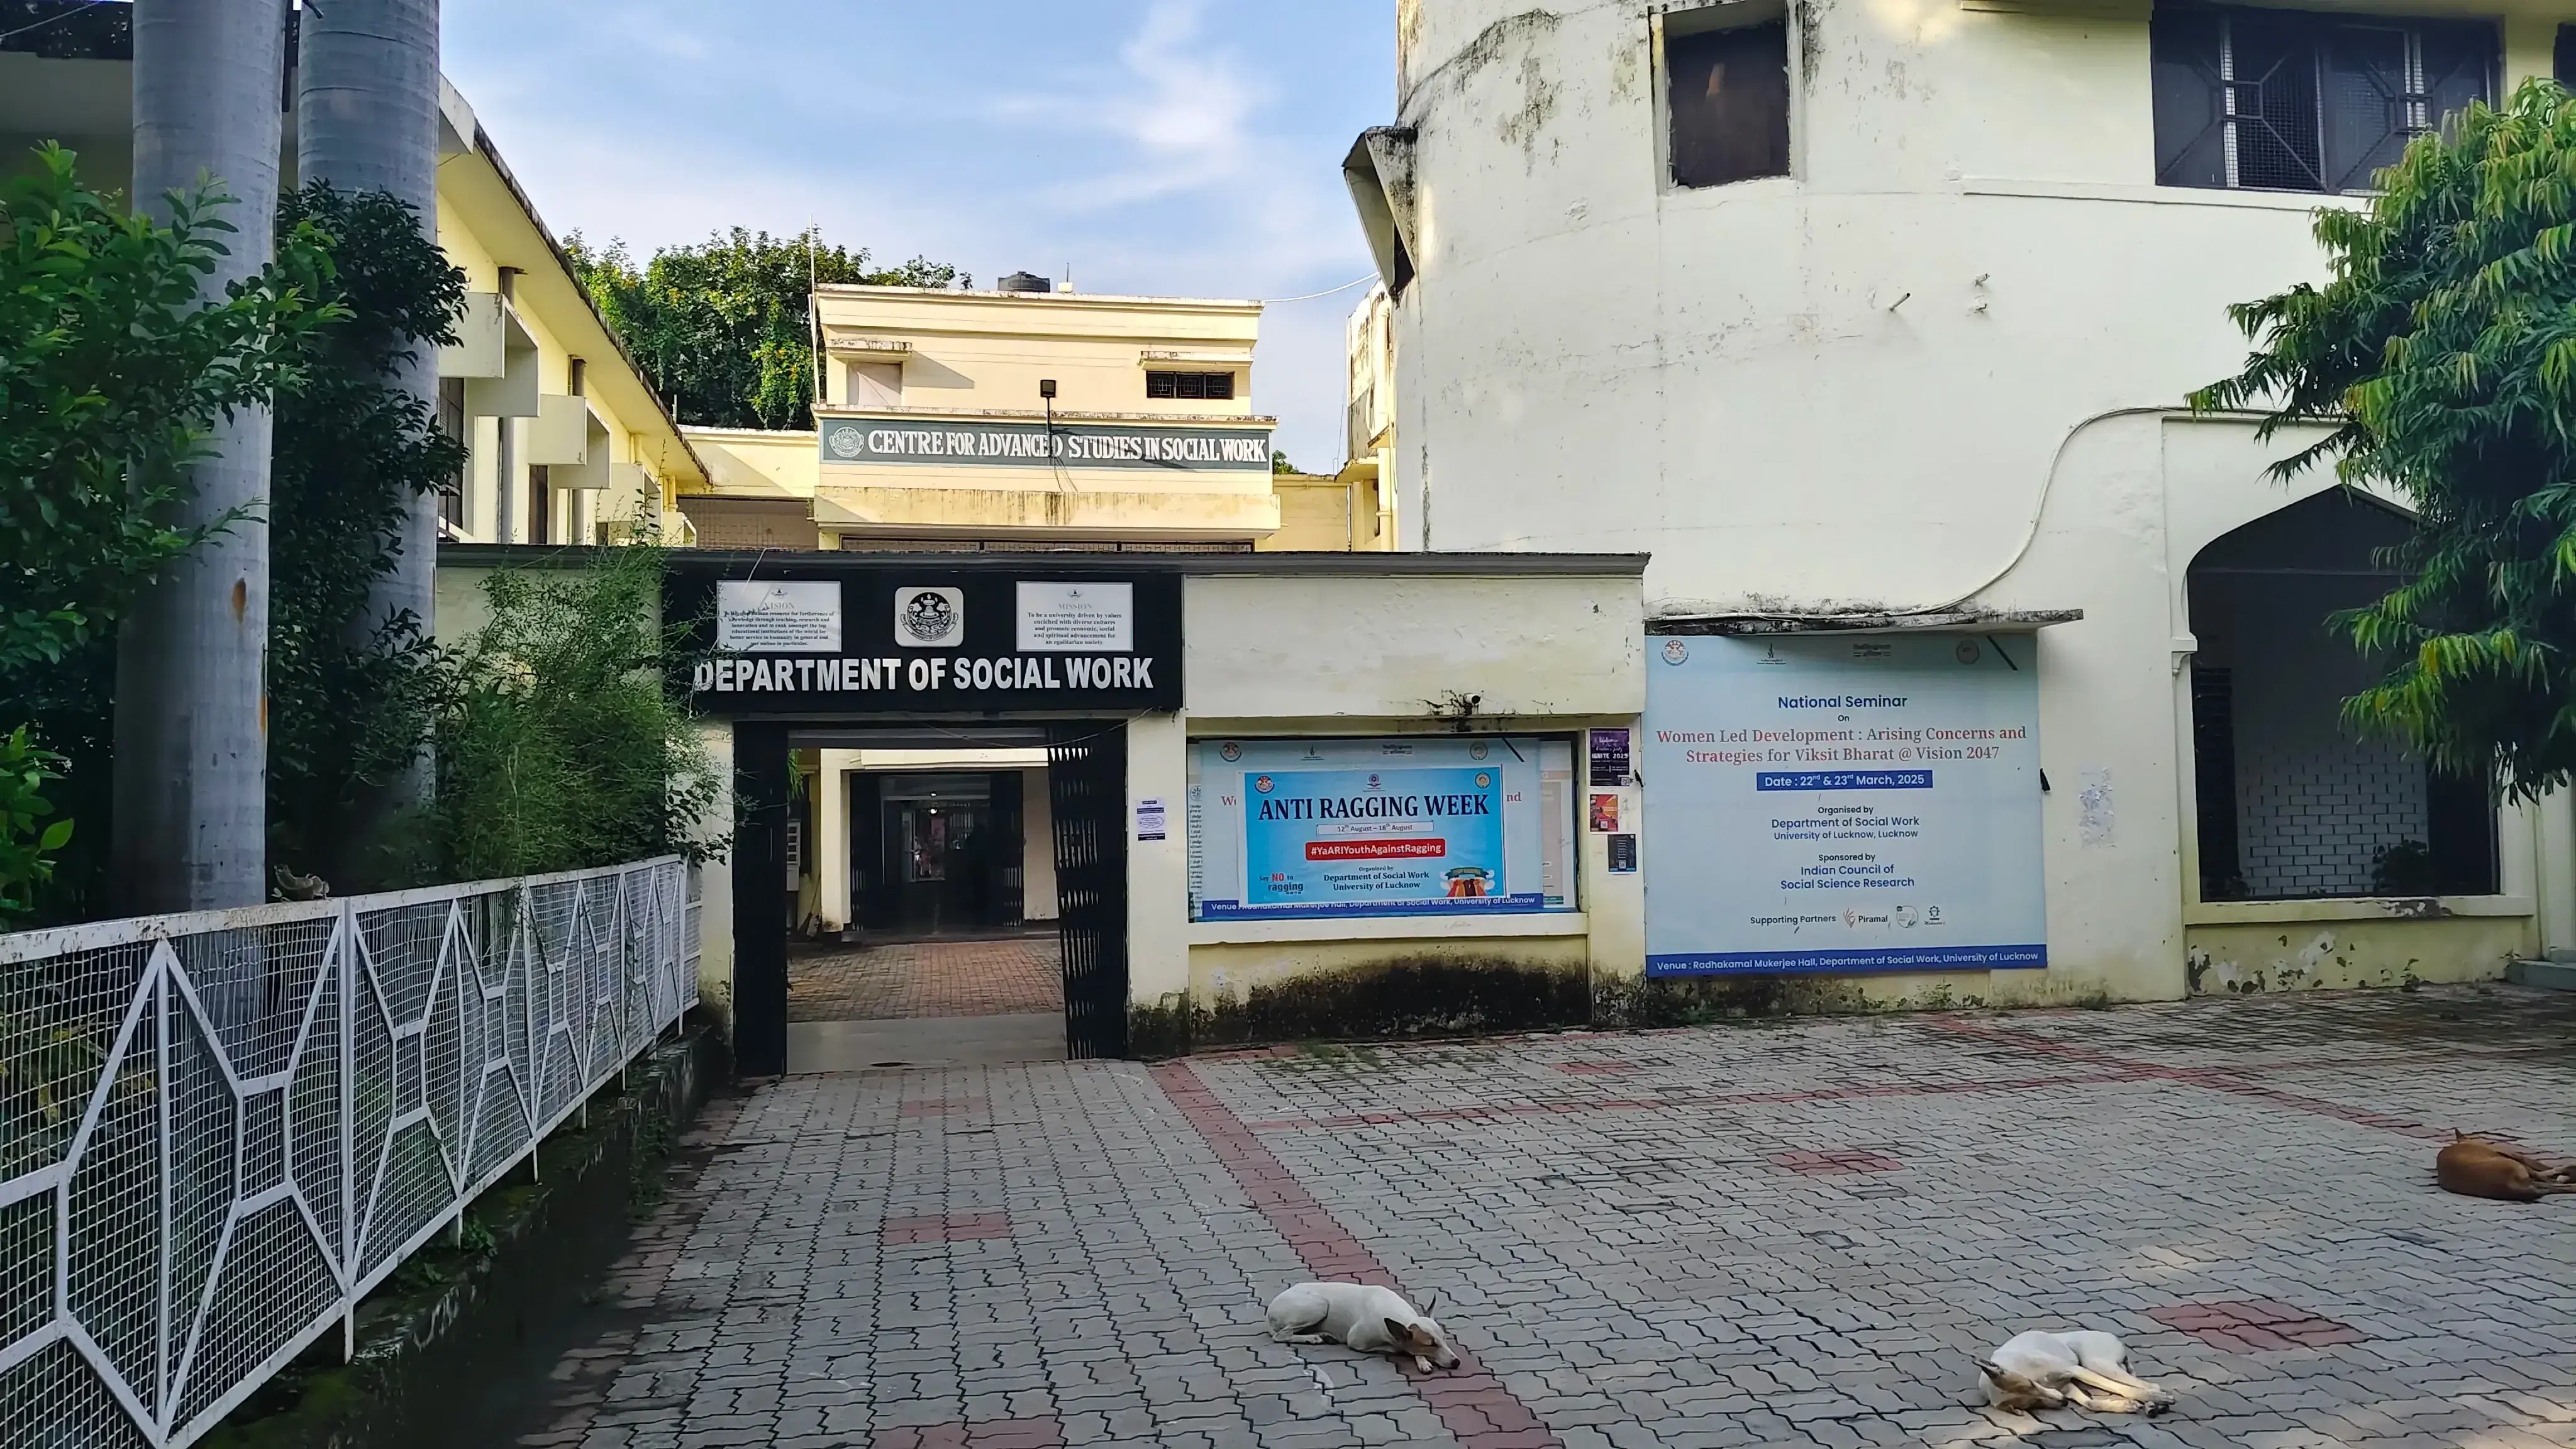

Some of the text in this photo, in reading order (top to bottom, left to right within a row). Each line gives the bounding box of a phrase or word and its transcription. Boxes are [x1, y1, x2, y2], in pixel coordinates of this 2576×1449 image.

[868, 430, 1267, 462] CENTRE FOR ADVANCED STUDIES IN SOCIAL WORK
[695, 657, 1153, 691] DEPARTMENT OF SOCIAL WORK
[1779, 694, 1907, 709] National Seminar
[1656, 730, 1715, 743] Women
[1719, 730, 1747, 742] Led
[1752, 729, 1853, 745] Development
[1867, 727, 1921, 743] Arising
[1926, 727, 1994, 740] Concerns
[1999, 726, 2026, 739] and
[1686, 747, 1999, 766] Strategies for Viksit Bharat @ Vision 2047
[1765, 777, 1792, 787] Date
[1823, 777, 1831, 786] &
[1856, 775, 1895, 786] March,
[1897, 775, 1924, 784] 2025
[1506, 791, 1522, 802] nd
[1258, 799, 1313, 821] ANTI
[1319, 796, 1418, 819] RAGGING
[1424, 794, 1489, 816] WEEK
[1818, 806, 1874, 815] Organised by
[1772, 816, 1919, 830] Department of Social Work
[1774, 831, 1820, 841] University
[1833, 831, 1876, 839] Lucknow,
[1818, 853, 1875, 863] Sponsored by
[1801, 864, 1894, 875] Indian Council of
[1272, 873, 1285, 881] NO
[1268, 882, 1303, 892] ragging
[1333, 882, 1374, 891] University
[1780, 877, 1914, 889] Social Science Research
[1750, 915, 1836, 925] Supporting Partners
[1858, 915, 1888, 923] Piramal
[1693, 960, 1752, 970] Radhakamal
[1755, 958, 1796, 969] Mukerjee
[1798, 958, 1818, 967] Hall,
[1819, 957, 1874, 966] Department
[1876, 956, 1886, 965] of
[1887, 956, 1914, 965] Social
[1916, 955, 1941, 963] Work,
[1943, 953, 1987, 963] University
[1989, 952, 1997, 962] of
[1999, 952, 2038, 961] Lucknow
